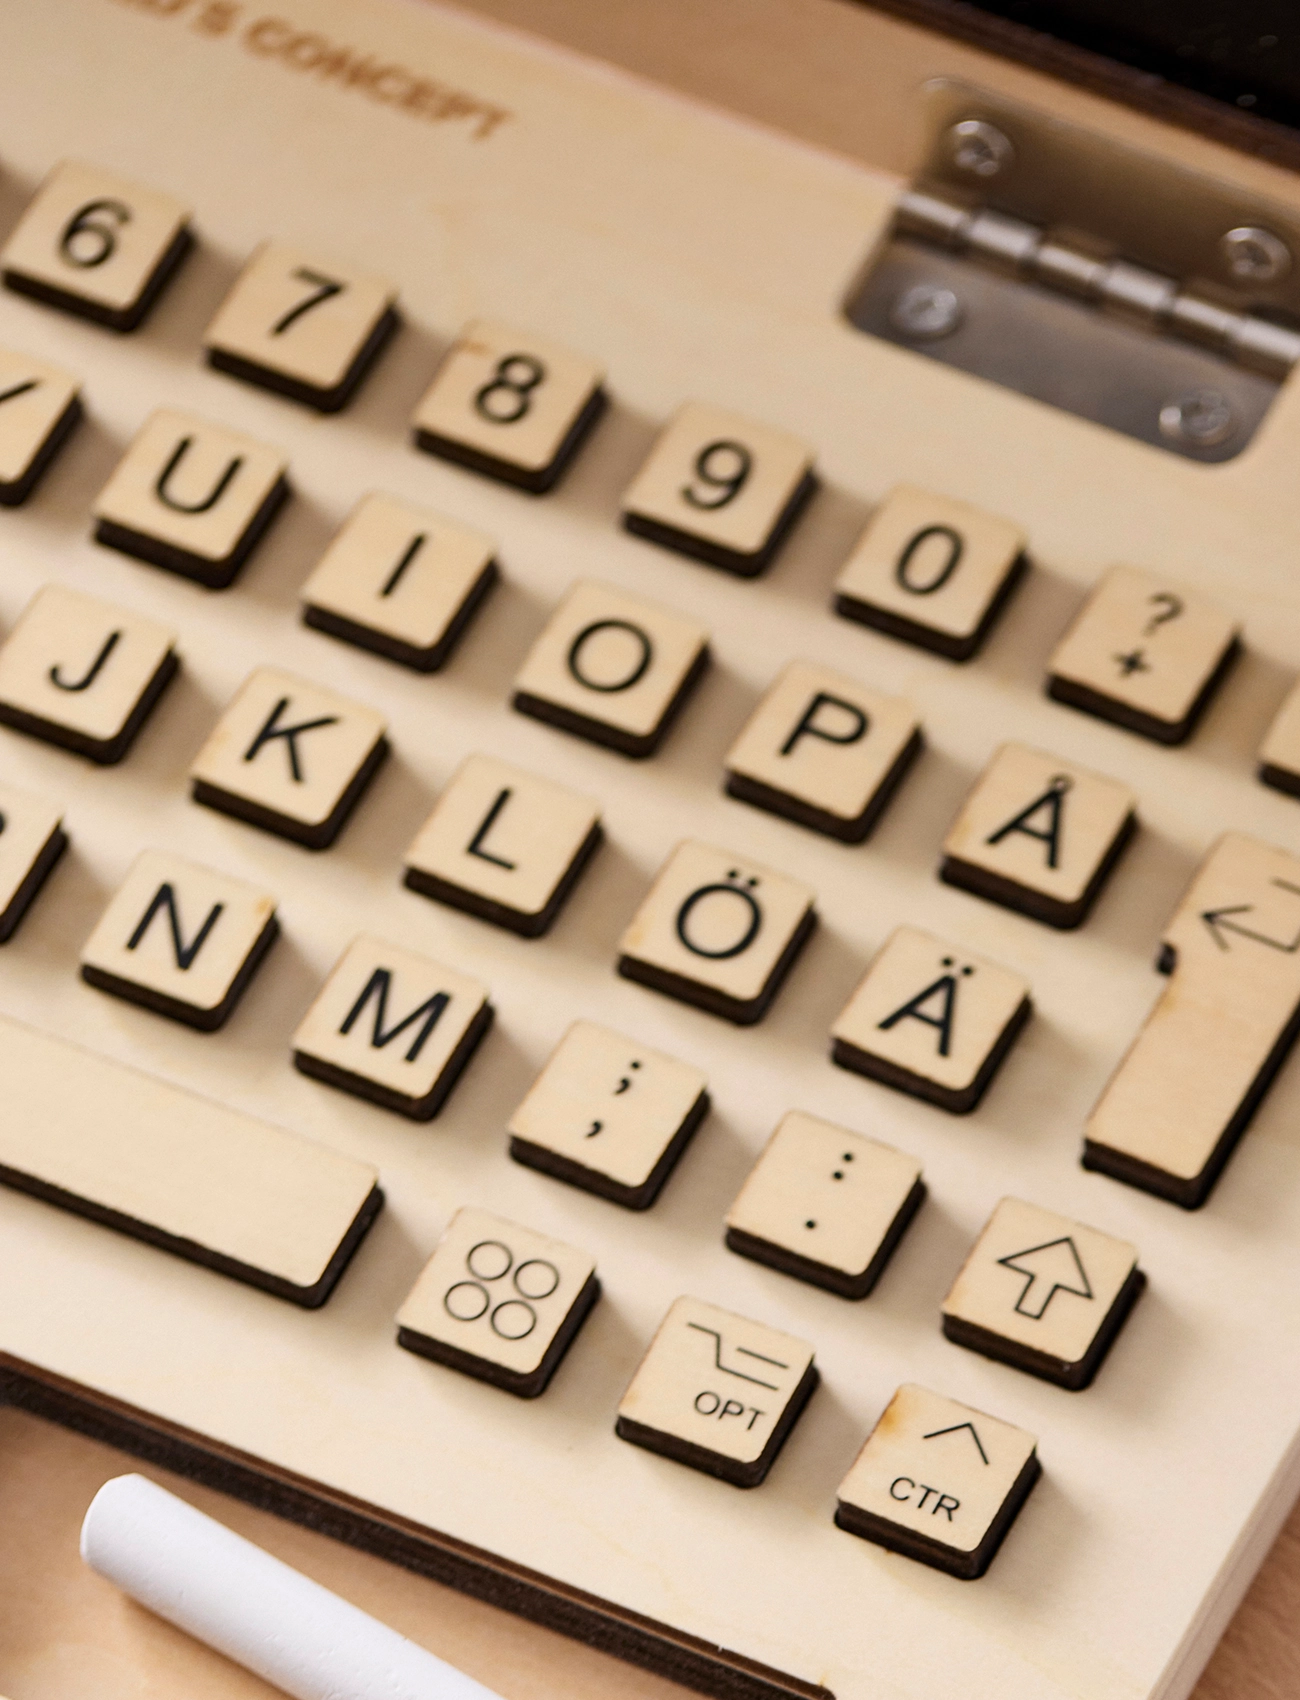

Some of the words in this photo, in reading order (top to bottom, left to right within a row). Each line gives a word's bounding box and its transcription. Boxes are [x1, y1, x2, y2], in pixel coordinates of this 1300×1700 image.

[242, 15, 514, 142] CONCEPT
[59, 200, 130, 269] 6
[273, 269, 345, 336] 7
[473, 354, 546, 425] 8
[154, 437, 243, 515] U
[682, 440, 753, 512] 9
[381, 534, 426, 598] I
[894, 524, 965, 597] 0
[1146, 592, 1185, 638] ?
[49, 631, 121, 693] J
[566, 619, 654, 694] O
[243, 697, 340, 784] K
[780, 691, 870, 756] P
[466, 788, 515, 871] L
[985, 774, 1073, 869] Å
[126, 882, 224, 971] N
[675, 870, 763, 961] Ö
[338, 966, 452, 1064] M
[873, 956, 974, 1058] Ä
[692, 1389, 767, 1432] OPT
[888, 1475, 962, 1524] CTR
